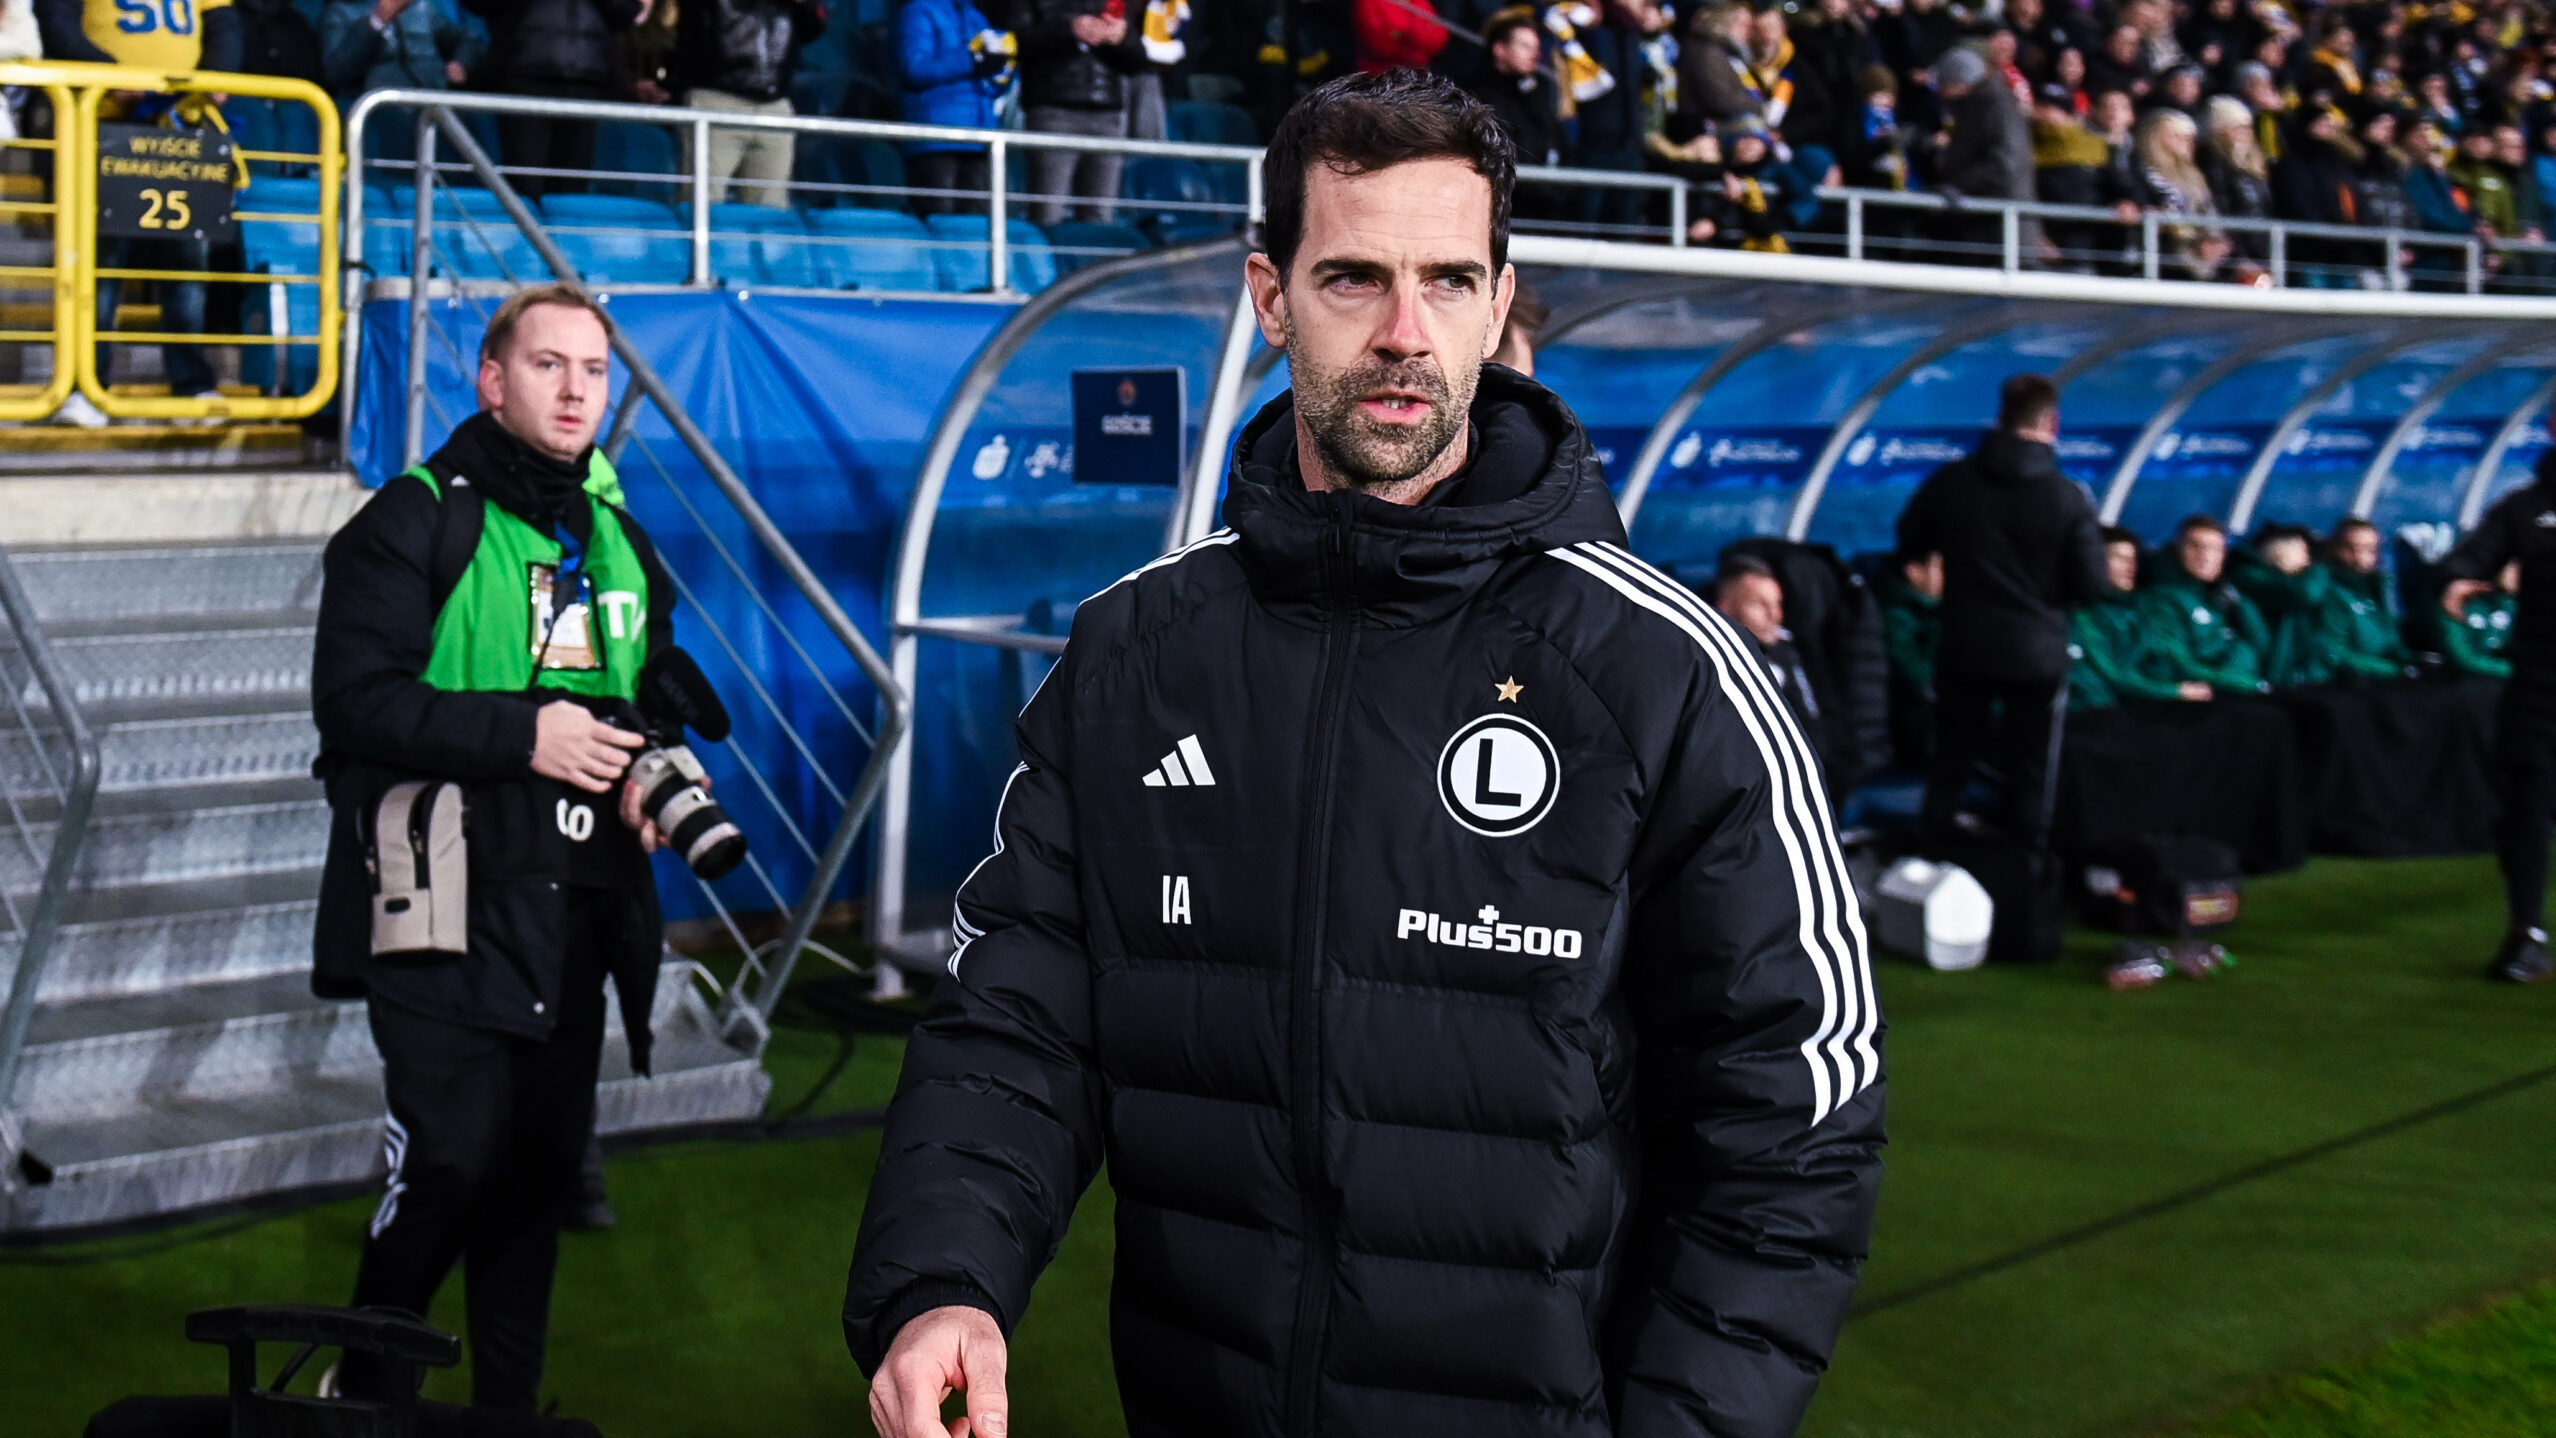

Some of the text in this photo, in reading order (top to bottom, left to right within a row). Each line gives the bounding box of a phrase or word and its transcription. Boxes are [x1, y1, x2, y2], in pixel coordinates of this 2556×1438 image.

[139, 188, 191, 230] 25
[1475, 738, 1521, 807] L
[1162, 875, 1192, 925] IA
[1398, 905, 1582, 959] Plus500
